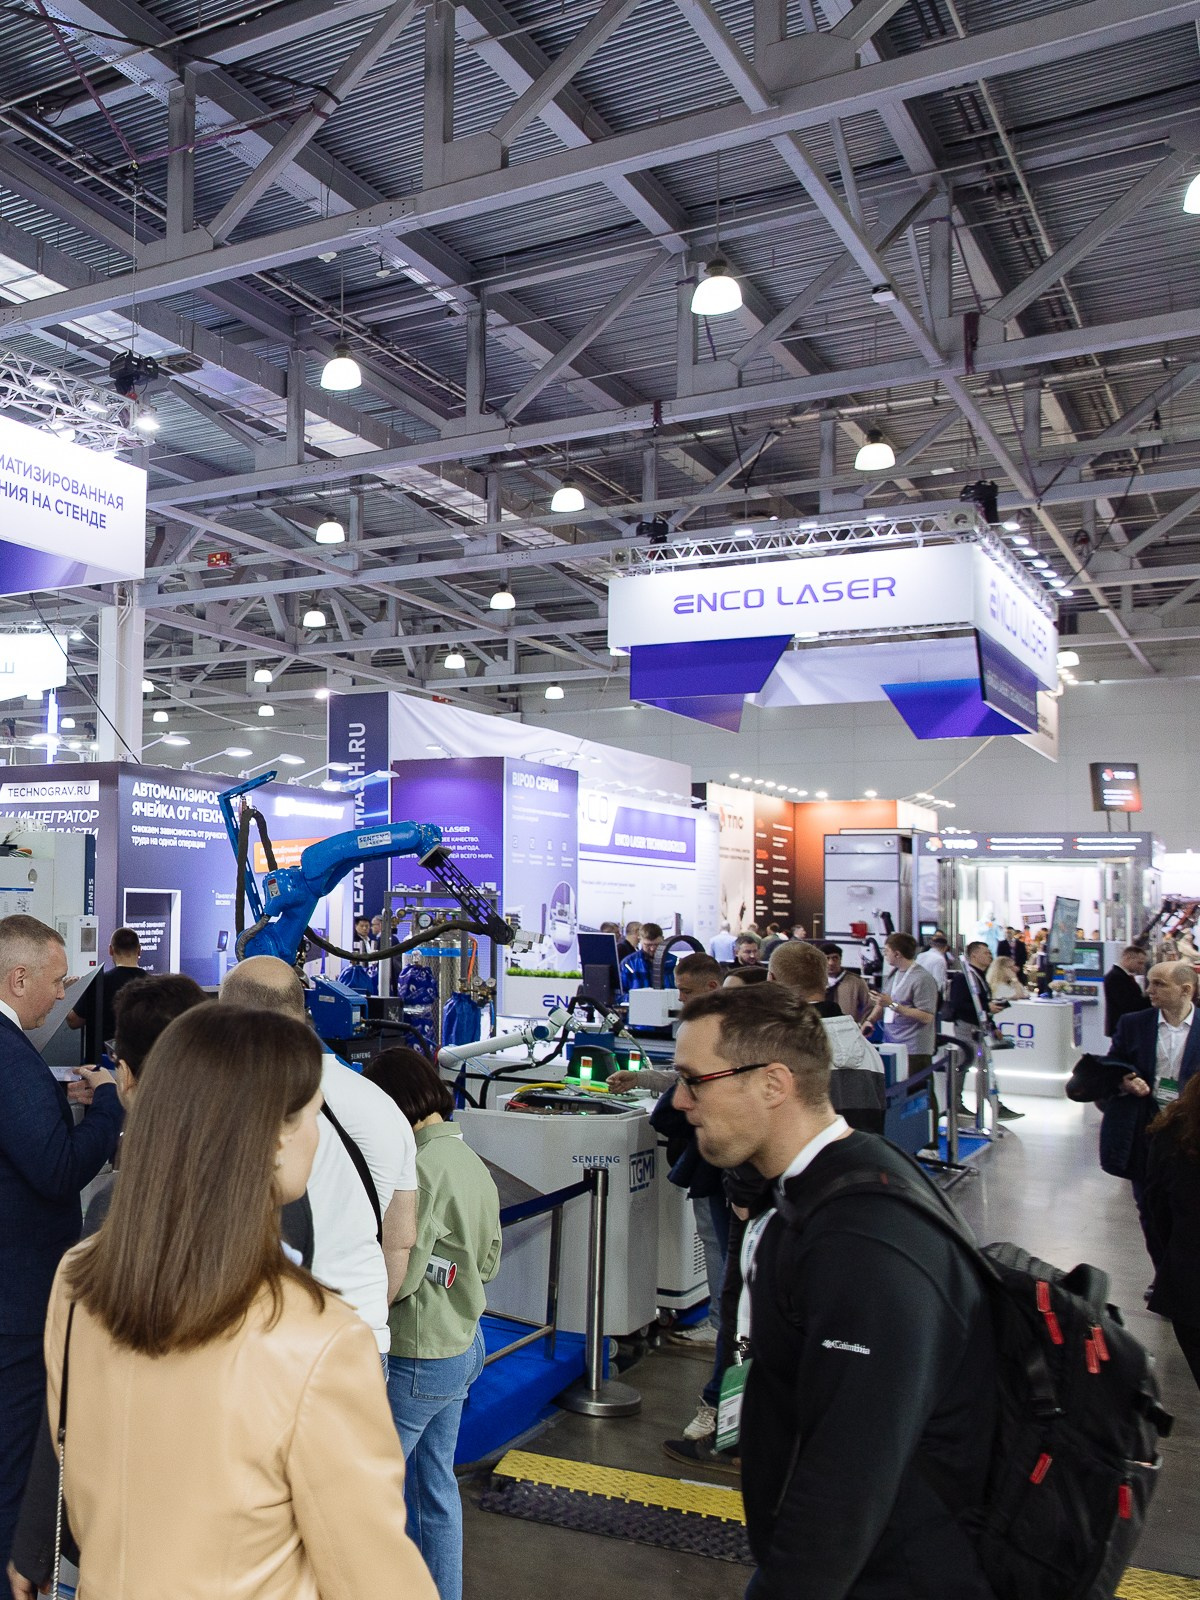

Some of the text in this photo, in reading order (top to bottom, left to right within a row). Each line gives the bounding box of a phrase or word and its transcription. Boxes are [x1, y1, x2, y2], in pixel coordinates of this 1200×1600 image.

[32, 490, 51, 511] НА
[55, 499, 107, 529] СТЕНДЕ
[673, 576, 896, 615] ENCO LASER
[8, 786, 91, 797] TECHNOGRAV.RU
[132, 800, 175, 820] ЯЧЕЙКА
[176, 806, 191, 821] ОТ
[727, 814, 744, 830] ТПС
[132, 825, 159, 835] снижаем
[160, 827, 197, 838] зависимость
[205, 831, 227, 841] ручного
[131, 836, 206, 850] труда на одной операции
[543, 994, 569, 1009] EN
[998, 1022, 1034, 1039] CO
[350, 1051, 371, 1060] SENFENG
[572, 1155, 620, 1164] SENFENG
[630, 1152, 654, 1188] TGM
